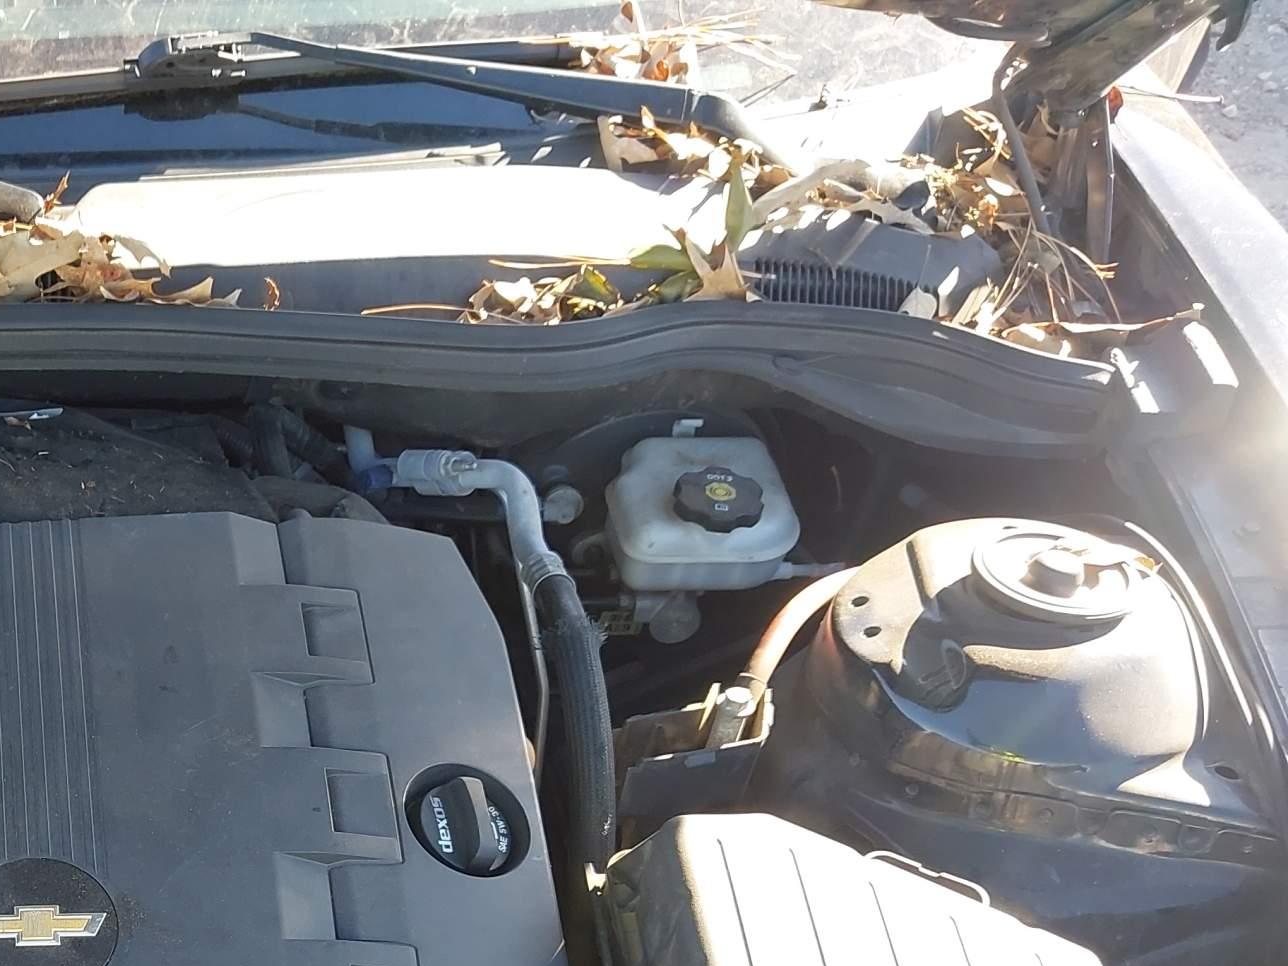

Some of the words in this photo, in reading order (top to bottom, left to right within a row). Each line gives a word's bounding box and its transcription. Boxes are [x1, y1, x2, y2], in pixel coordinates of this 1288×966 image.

[430, 794, 454, 853] dexos
[488, 806, 507, 835] 5W-30
[498, 838, 508, 853] SAE
